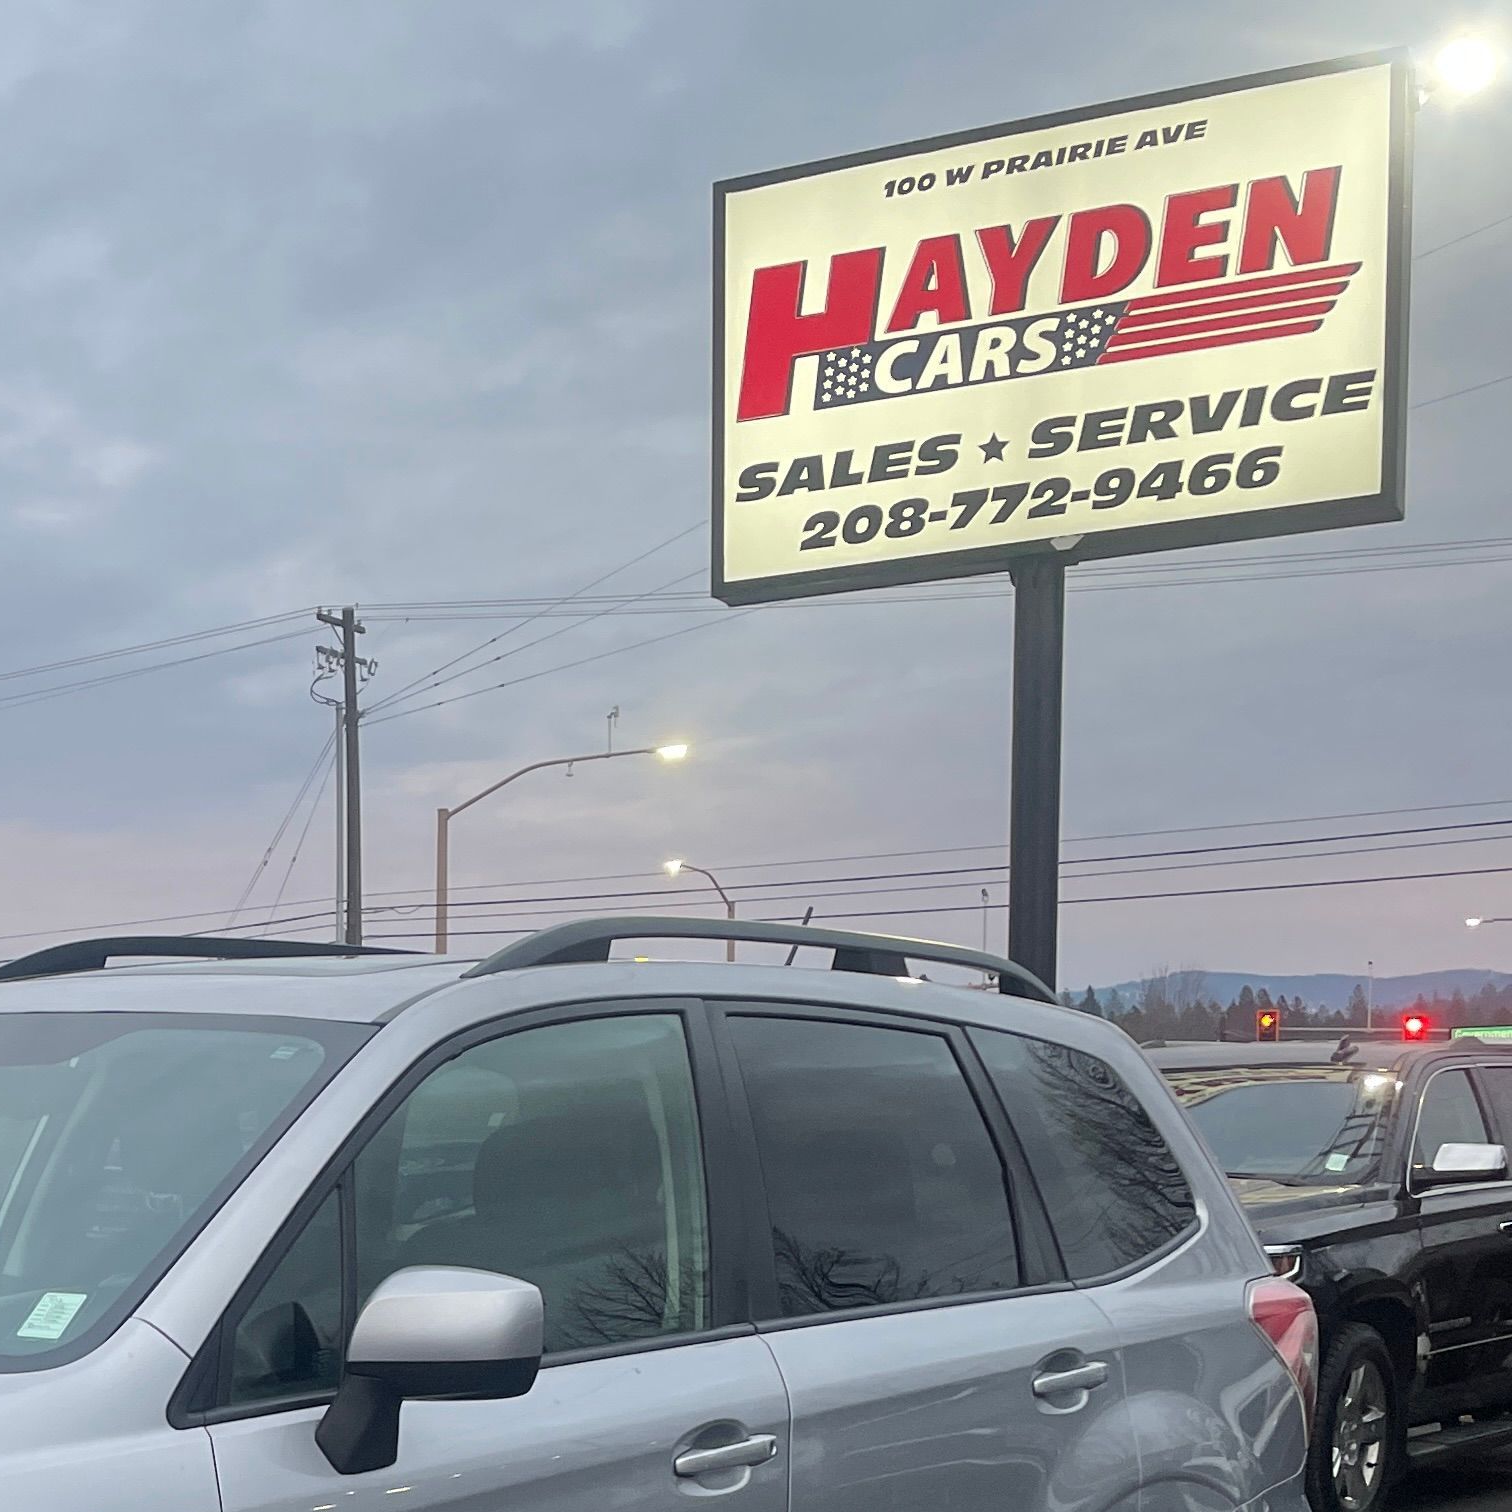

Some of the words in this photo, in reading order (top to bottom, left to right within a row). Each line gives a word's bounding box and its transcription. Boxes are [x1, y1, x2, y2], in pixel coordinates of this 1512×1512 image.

[884, 171, 935, 198] 100
[944, 166, 975, 185] W
[982, 135, 1130, 180] PRAIRIE
[1134, 119, 1208, 151] AVE
[736, 166, 1343, 423] HAYDEN
[874, 317, 1062, 394] CARS
[735, 433, 963, 503] SALES
[1027, 369, 1377, 459] SERVICE
[800, 446, 1285, 551] 208-772-9466
